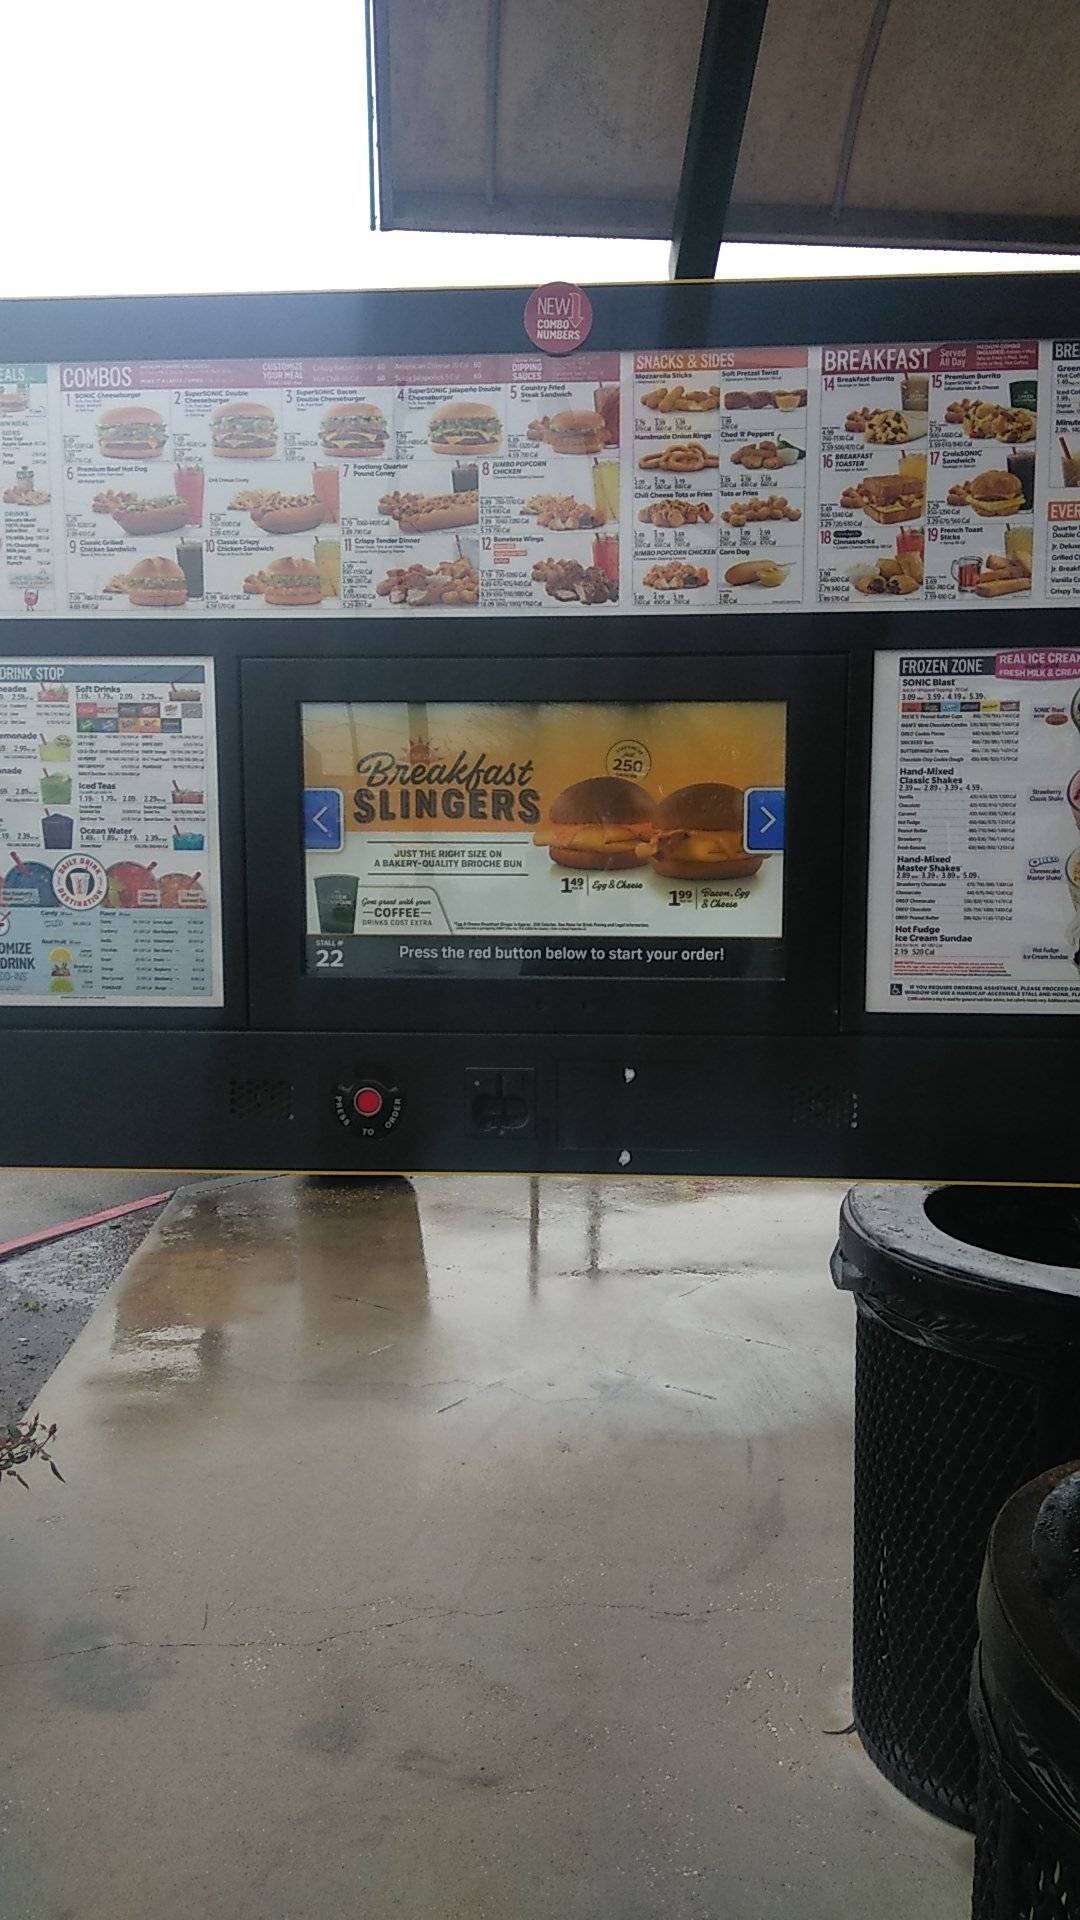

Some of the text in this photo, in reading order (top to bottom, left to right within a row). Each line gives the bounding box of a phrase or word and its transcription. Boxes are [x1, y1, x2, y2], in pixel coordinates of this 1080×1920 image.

[537, 297, 570, 315] NEW
[537, 319, 569, 329] COMBO
[537, 330, 580, 340] NUMBERS
[824, 348, 931, 371] BREAKFAST
[940, 349, 966, 357] Served
[263, 362, 303, 370] CUSTOMIZE
[637, 353, 735, 369] SNACKS & SIDES
[952, 358, 966, 367] Day
[63, 367, 132, 388] COMBOS
[512, 372, 542, 380] SAUCES
[932, 375, 942, 388] 15
[824, 377, 835, 391] 14
[174, 392, 181, 404] 2
[286, 390, 292, 403] 3
[398, 389, 404, 400] 4
[511, 386, 517, 399] 5
[822, 454, 833, 468] 16
[930, 452, 939, 465] 17
[66, 467, 73, 480] 6
[344, 464, 349, 477] 7
[482, 462, 489, 475] 8
[821, 530, 831, 544] 18
[928, 527, 938, 542] 19
[70, 540, 77, 553] 9
[205, 539, 215, 553] 10
[344, 538, 352, 551] 11
[482, 537, 491, 550] 12
[1000, 655, 1026, 664] REAL
[1029, 654, 1044, 664] ICE
[902, 658, 983, 674] FROZEN ZONE
[0, 667, 64, 681] DRINK STOP
[1000, 669, 1025, 677] FRESH
[357, 750, 534, 791] Breakfast
[613, 759, 642, 772] 250
[353, 789, 541, 824] SLINGERS
[80, 827, 132, 835] Ocean Water
[394, 850, 502, 858] JUST THE RIGHT SIZE ON
[58, 858, 101, 874] DAILY DRINK
[383, 860, 459, 868] BAKERY-QUALITY
[461, 860, 501, 868] BRIOCHE
[504, 860, 522, 868] BUN
[592, 880, 643, 890] Egg & Cheese
[58, 888, 103, 907] DESTINATION
[701, 888, 750, 899] Bacon, Egg
[361, 897, 431, 907] Goes great with your
[701, 900, 738, 909] & Cheese
[374, 908, 420, 918] COFFEE
[913, 926, 940, 934] Fudge
[940, 935, 972, 943] Sundae
[0, 942, 31, 955] OMIZE
[400, 946, 724, 963] Press the red button below to start your order!
[0, 957, 35, 970] DRINK
[315, 950, 344, 968] 22
[335, 1095, 401, 1136] PRESS TO ORDER
